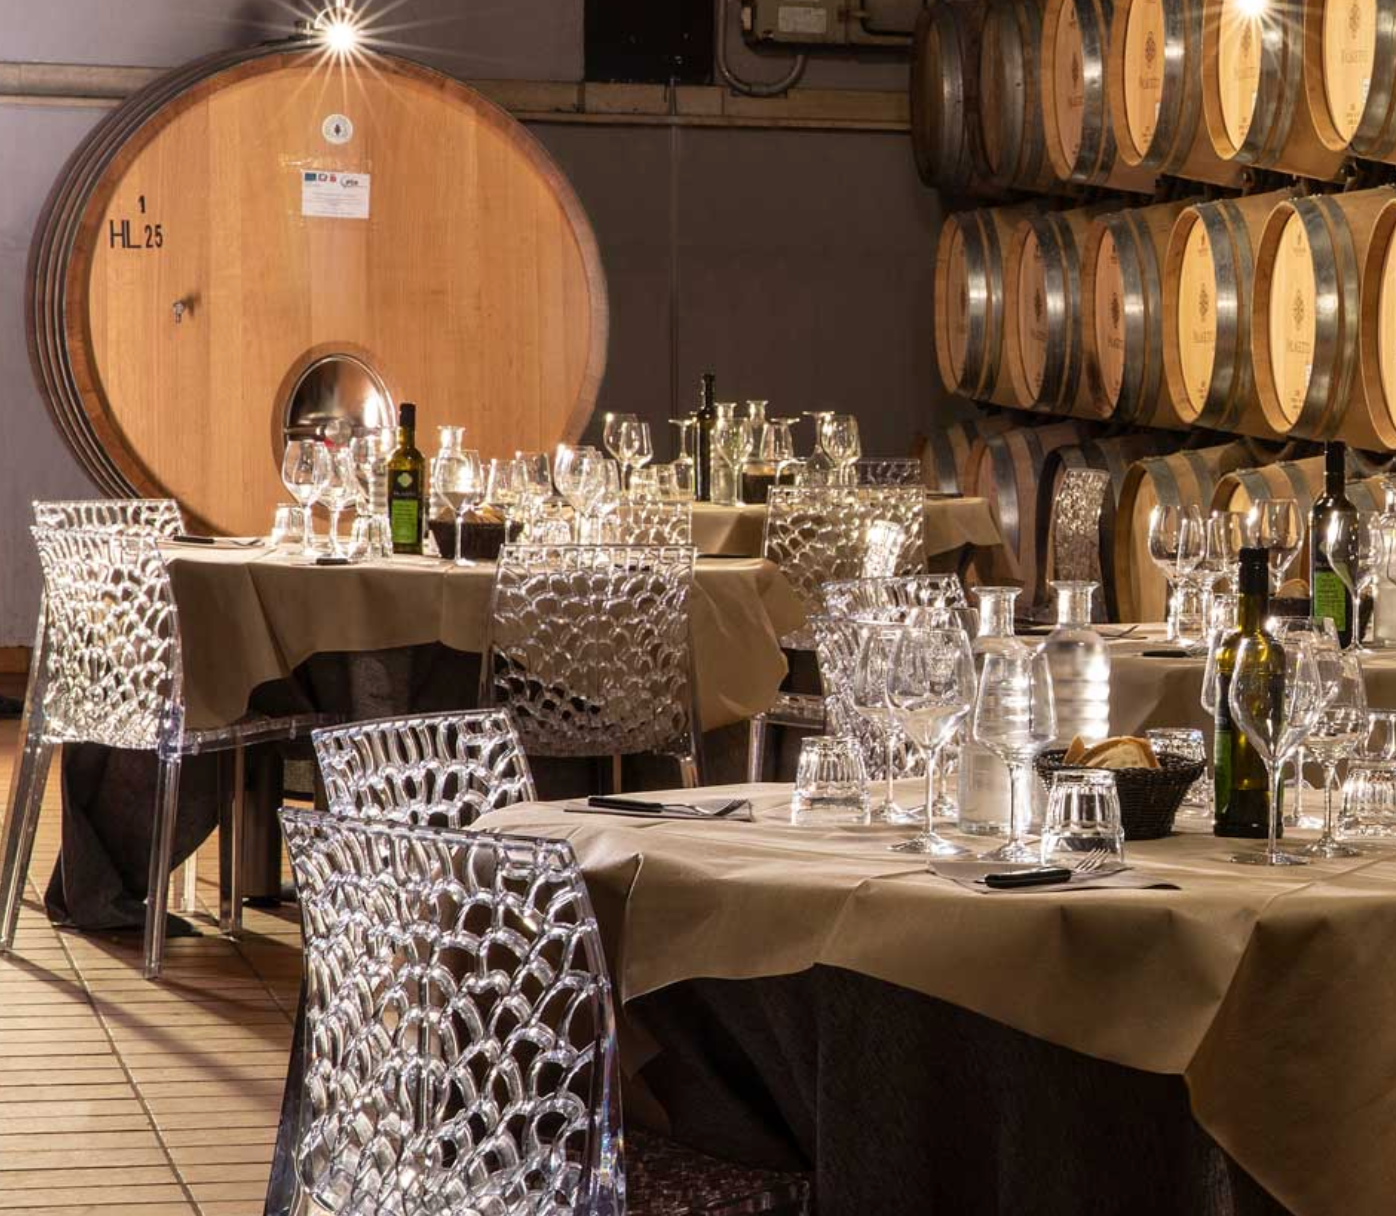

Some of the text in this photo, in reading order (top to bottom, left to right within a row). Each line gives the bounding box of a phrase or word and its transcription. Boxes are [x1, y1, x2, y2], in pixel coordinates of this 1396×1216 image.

[138, 196, 146, 213] 1
[109, 220, 163, 249] HL 25
